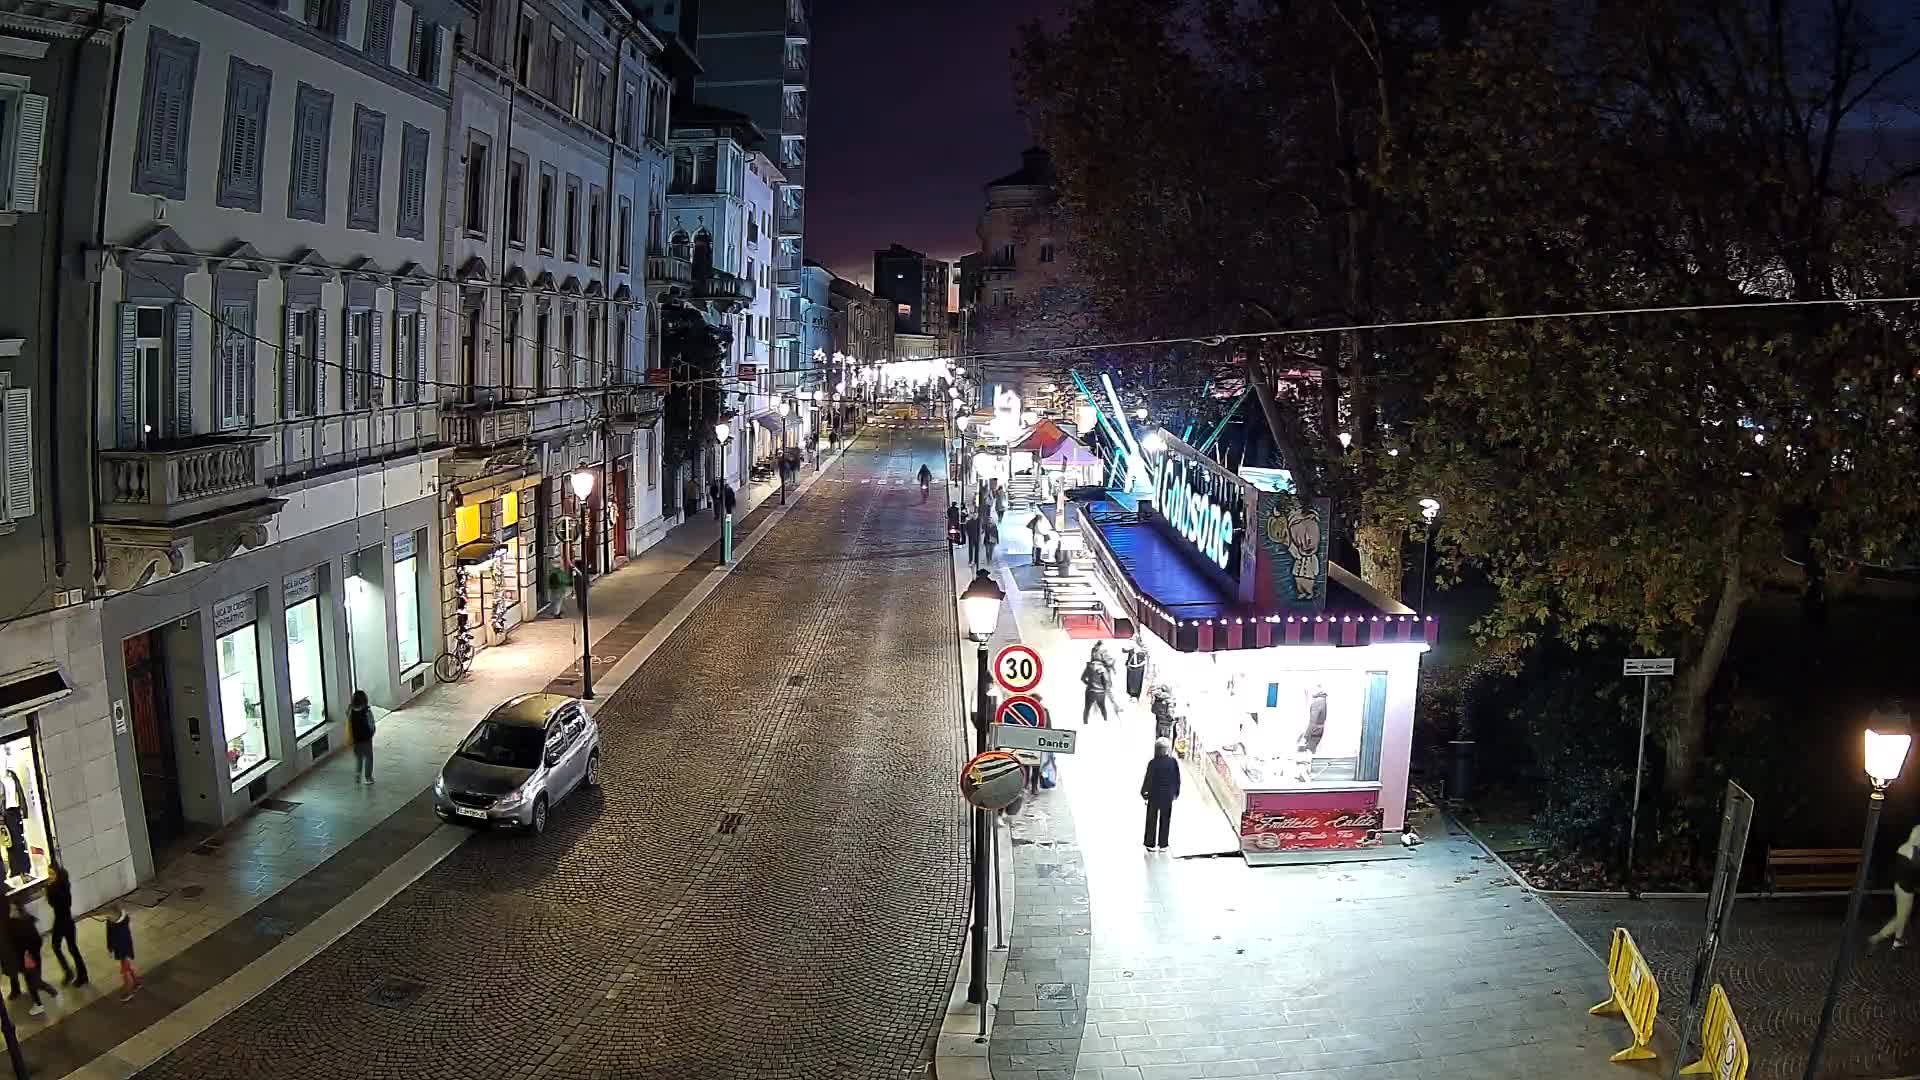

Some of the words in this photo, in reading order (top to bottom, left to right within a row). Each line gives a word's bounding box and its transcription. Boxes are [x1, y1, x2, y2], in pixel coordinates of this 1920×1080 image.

[1161, 458, 1233, 570] Golosone
[1006, 658, 1033, 680] 30
[1038, 737, 1069, 749] Dante
